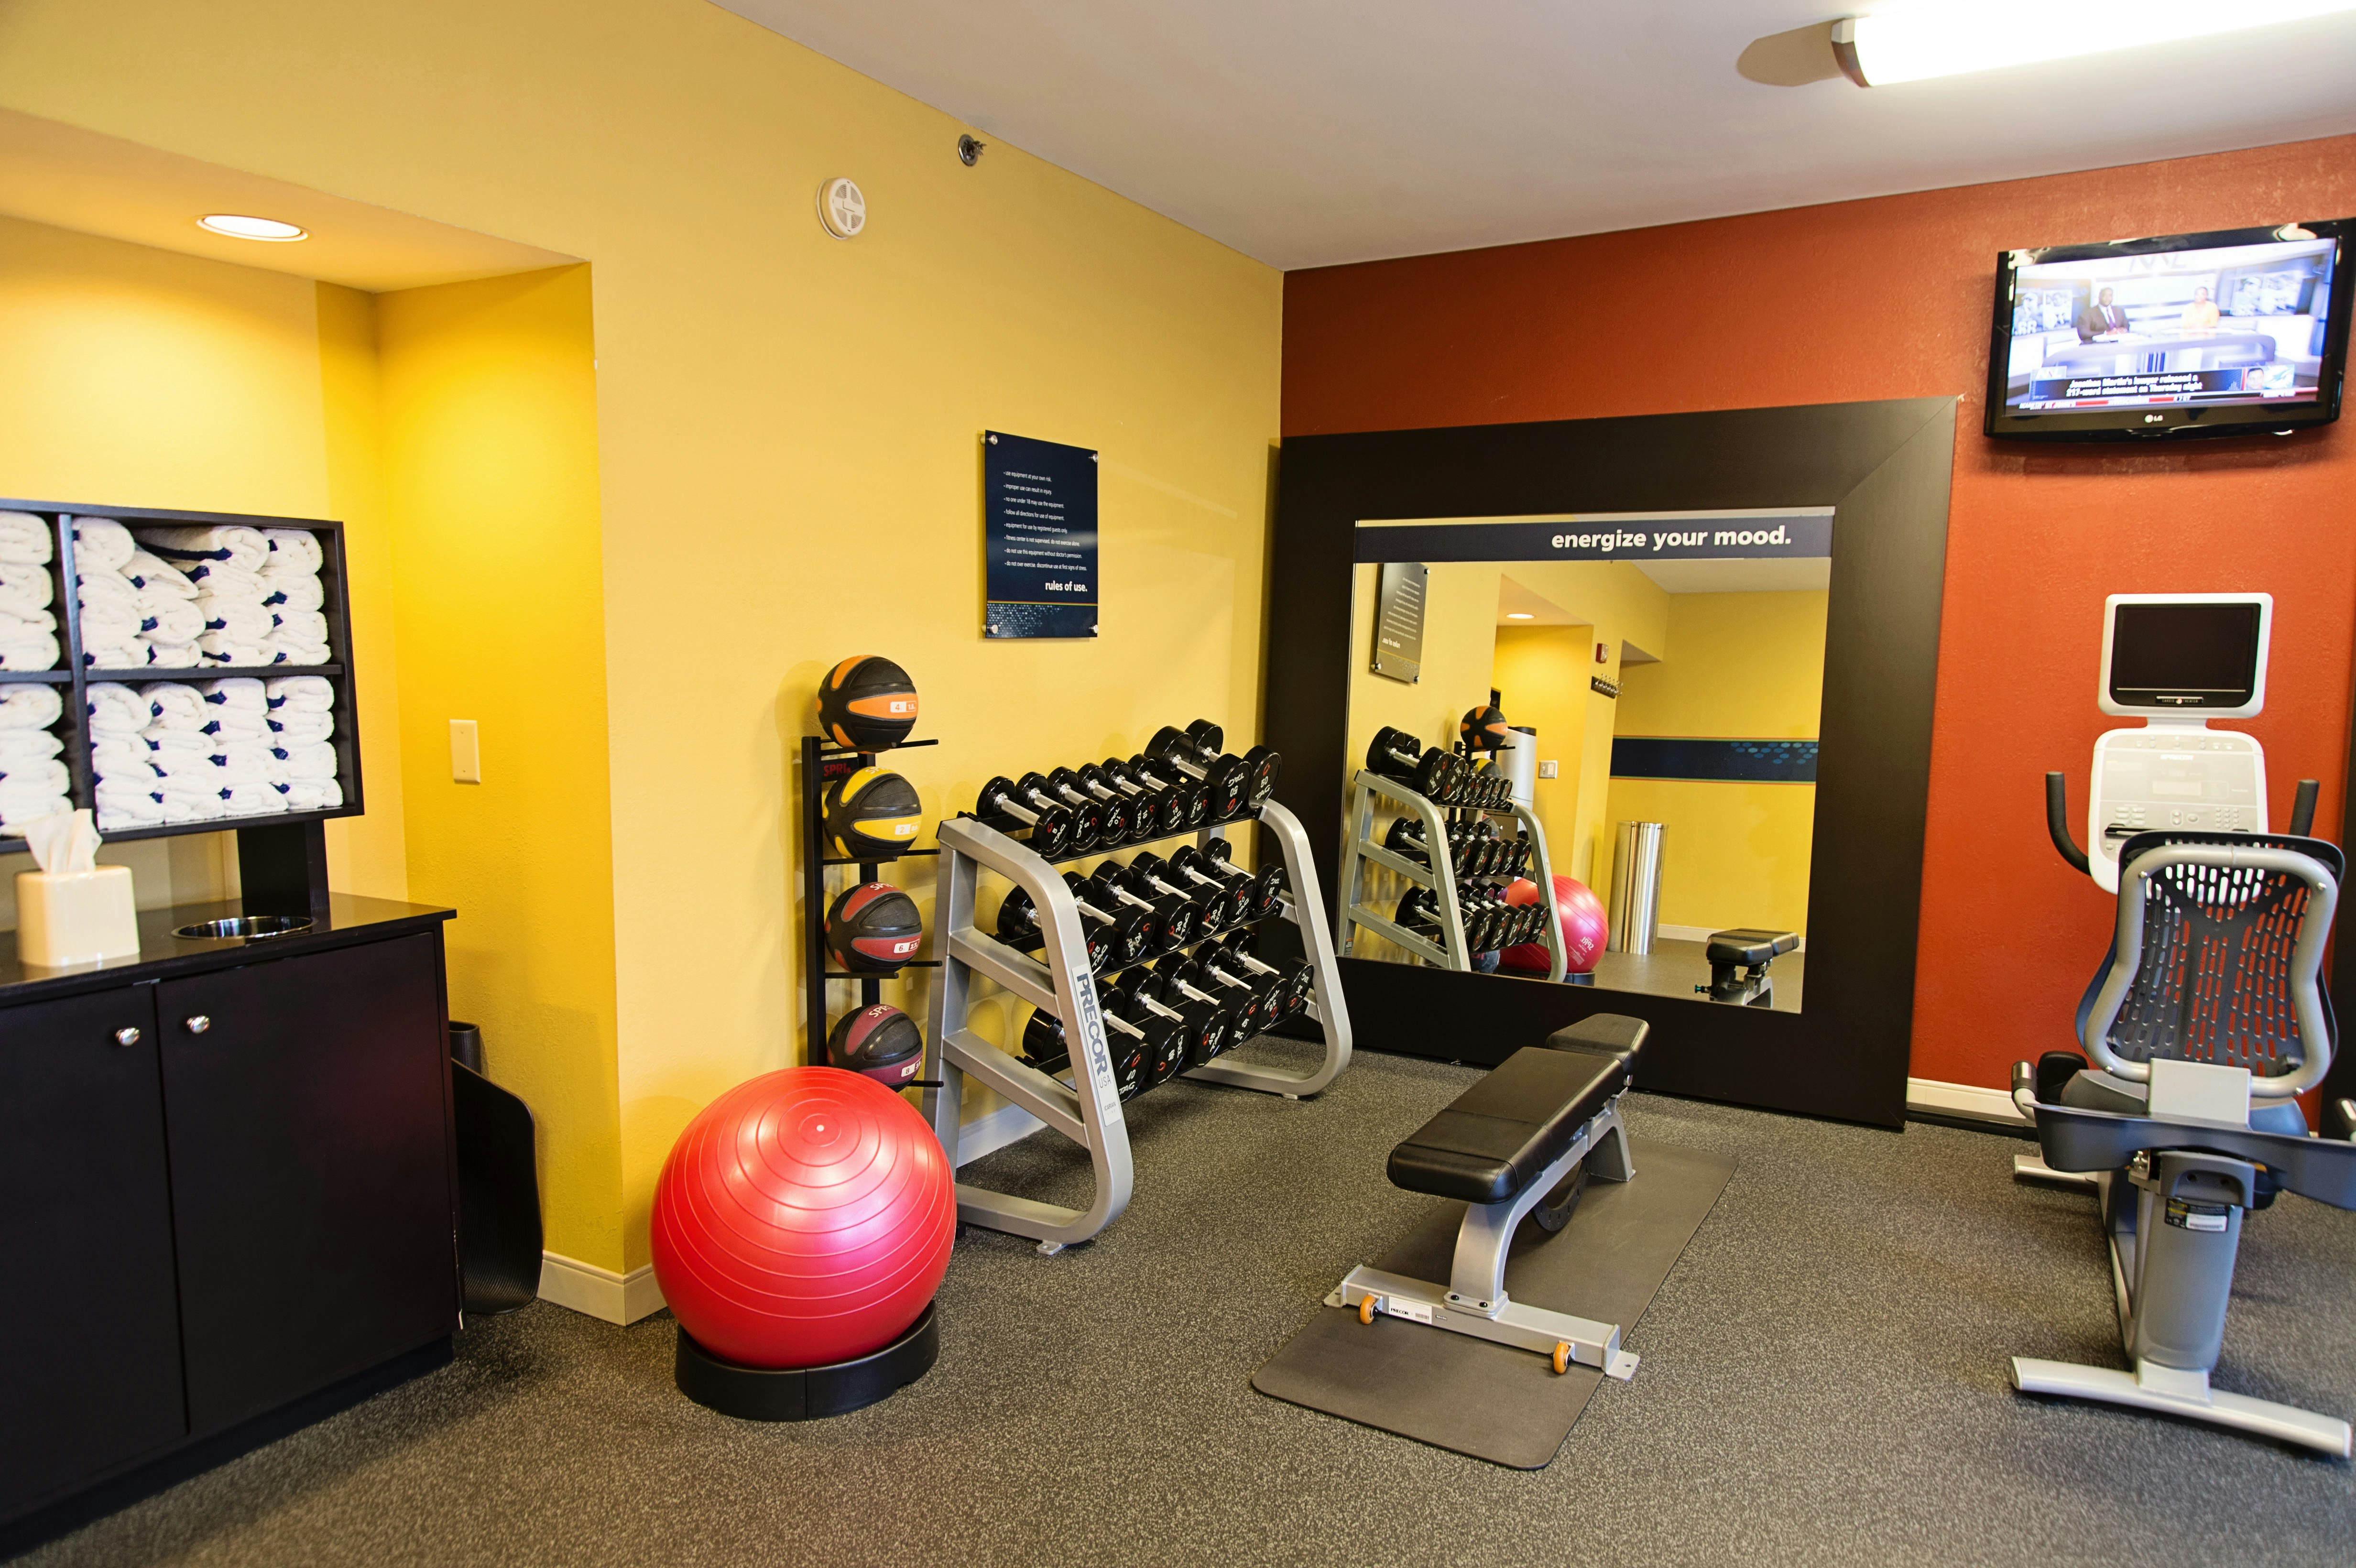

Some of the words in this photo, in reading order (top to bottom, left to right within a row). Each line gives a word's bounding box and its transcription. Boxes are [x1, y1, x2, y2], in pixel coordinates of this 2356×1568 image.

[1551, 529, 1647, 552] energize
[1653, 531, 1708, 552] your
[1714, 525, 1792, 546] mood.
[1045, 580, 1063, 591] rules
[1064, 581, 1072, 591] of
[1228, 772, 1244, 787] TAG
[1260, 776, 1268, 788] 50
[1230, 785, 1238, 797] 50
[1255, 784, 1271, 801] TAG
[1108, 807, 1120, 828] TAG
[1169, 810, 1182, 824] TAG
[1052, 823, 1066, 844] TAG
[1076, 817, 1084, 838] TAG
[1214, 901, 1225, 924] TAG
[1236, 898, 1249, 915] TAG
[1180, 912, 1190, 936] TAG
[1091, 944, 1108, 968] TAG
[1300, 973, 1309, 984] TAG
[1077, 972, 1108, 1077] PRECOR
[1210, 1025, 1224, 1052] TAG
[1234, 1030, 1244, 1041] TAG
[1098, 1074, 1112, 1089] USA
[1119, 1081, 1136, 1095] TAG
[1390, 1307, 1409, 1316] PRECOR
